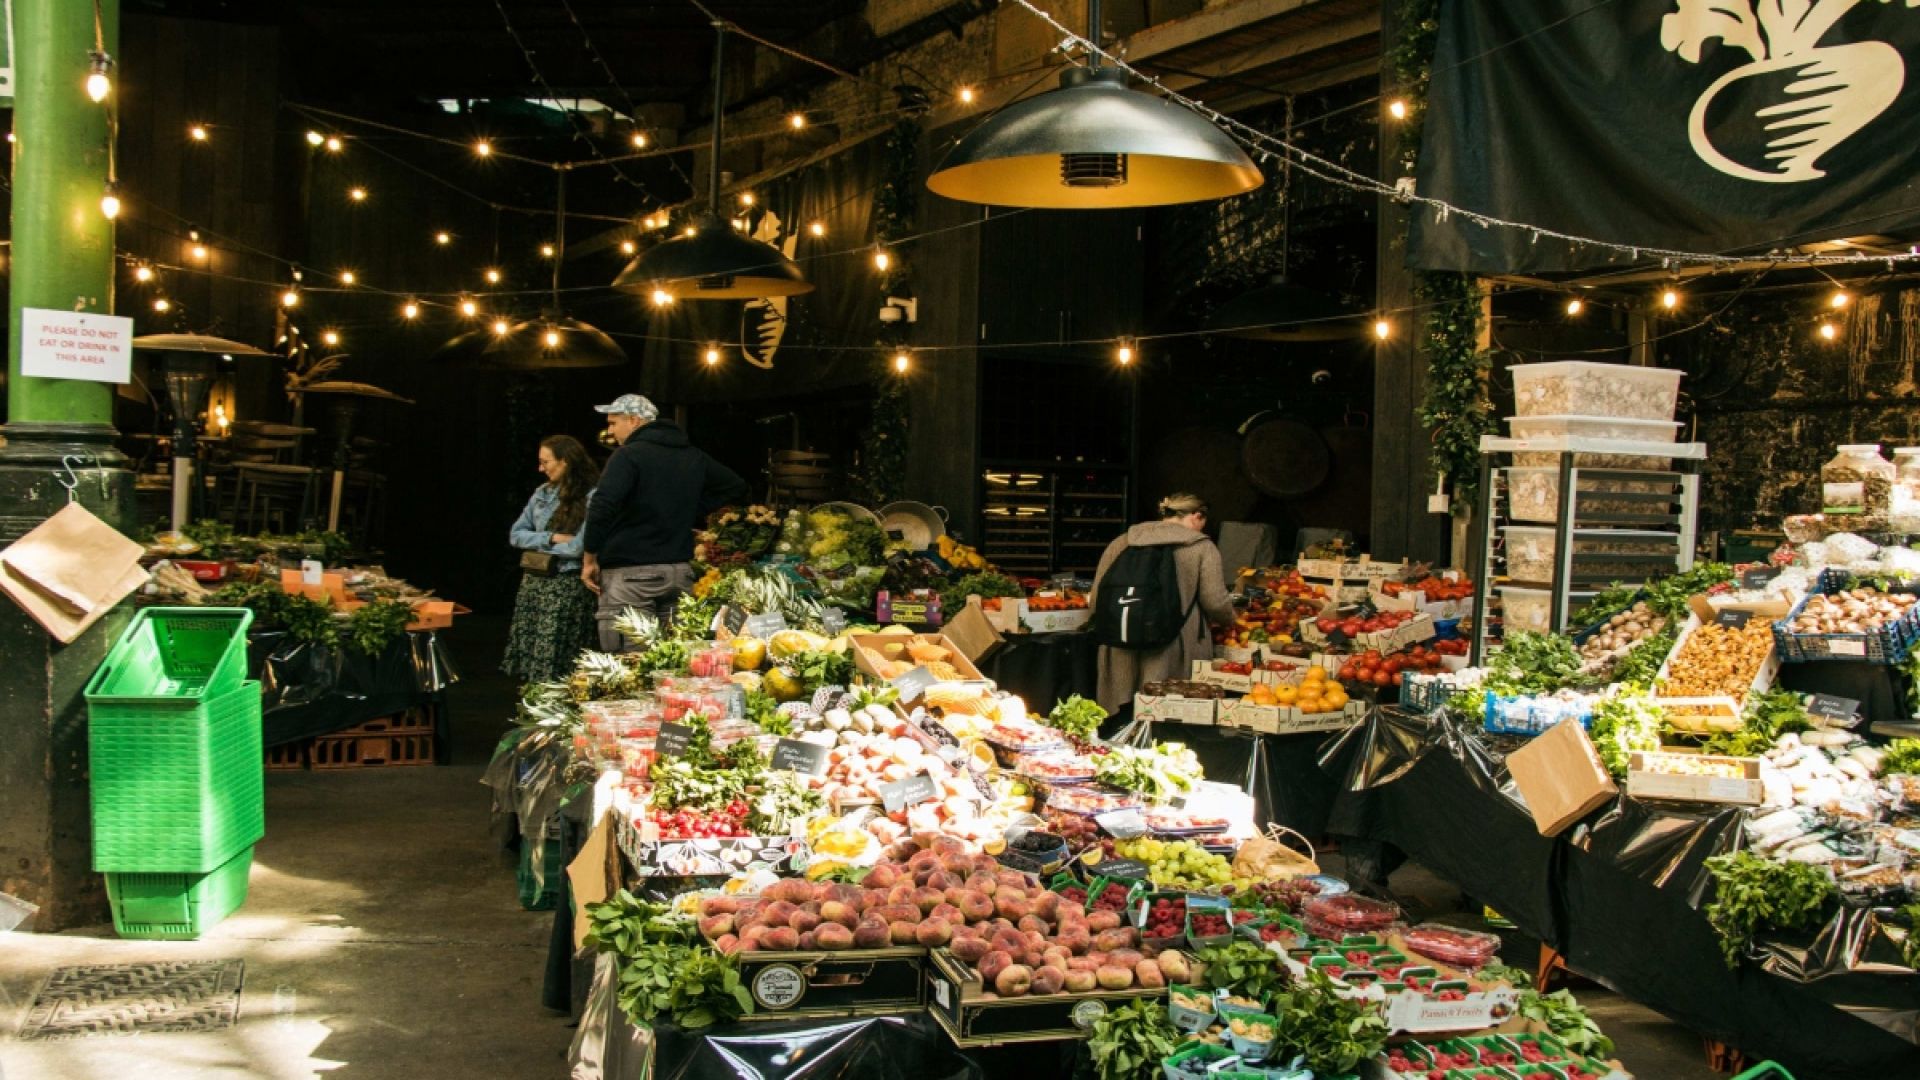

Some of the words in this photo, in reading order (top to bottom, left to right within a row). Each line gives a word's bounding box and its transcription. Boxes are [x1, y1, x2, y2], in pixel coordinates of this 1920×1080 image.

[42, 325, 78, 336] PLEASE
[81, 328, 96, 337] DO
[98, 330, 118, 339] NOT
[39, 338, 57, 347] EAT
[60, 340, 75, 348] OR
[79, 341, 108, 351] DRINK
[109, 344, 120, 352] IN
[55, 353, 77, 362] THIS
[80, 355, 105, 364] AREA
